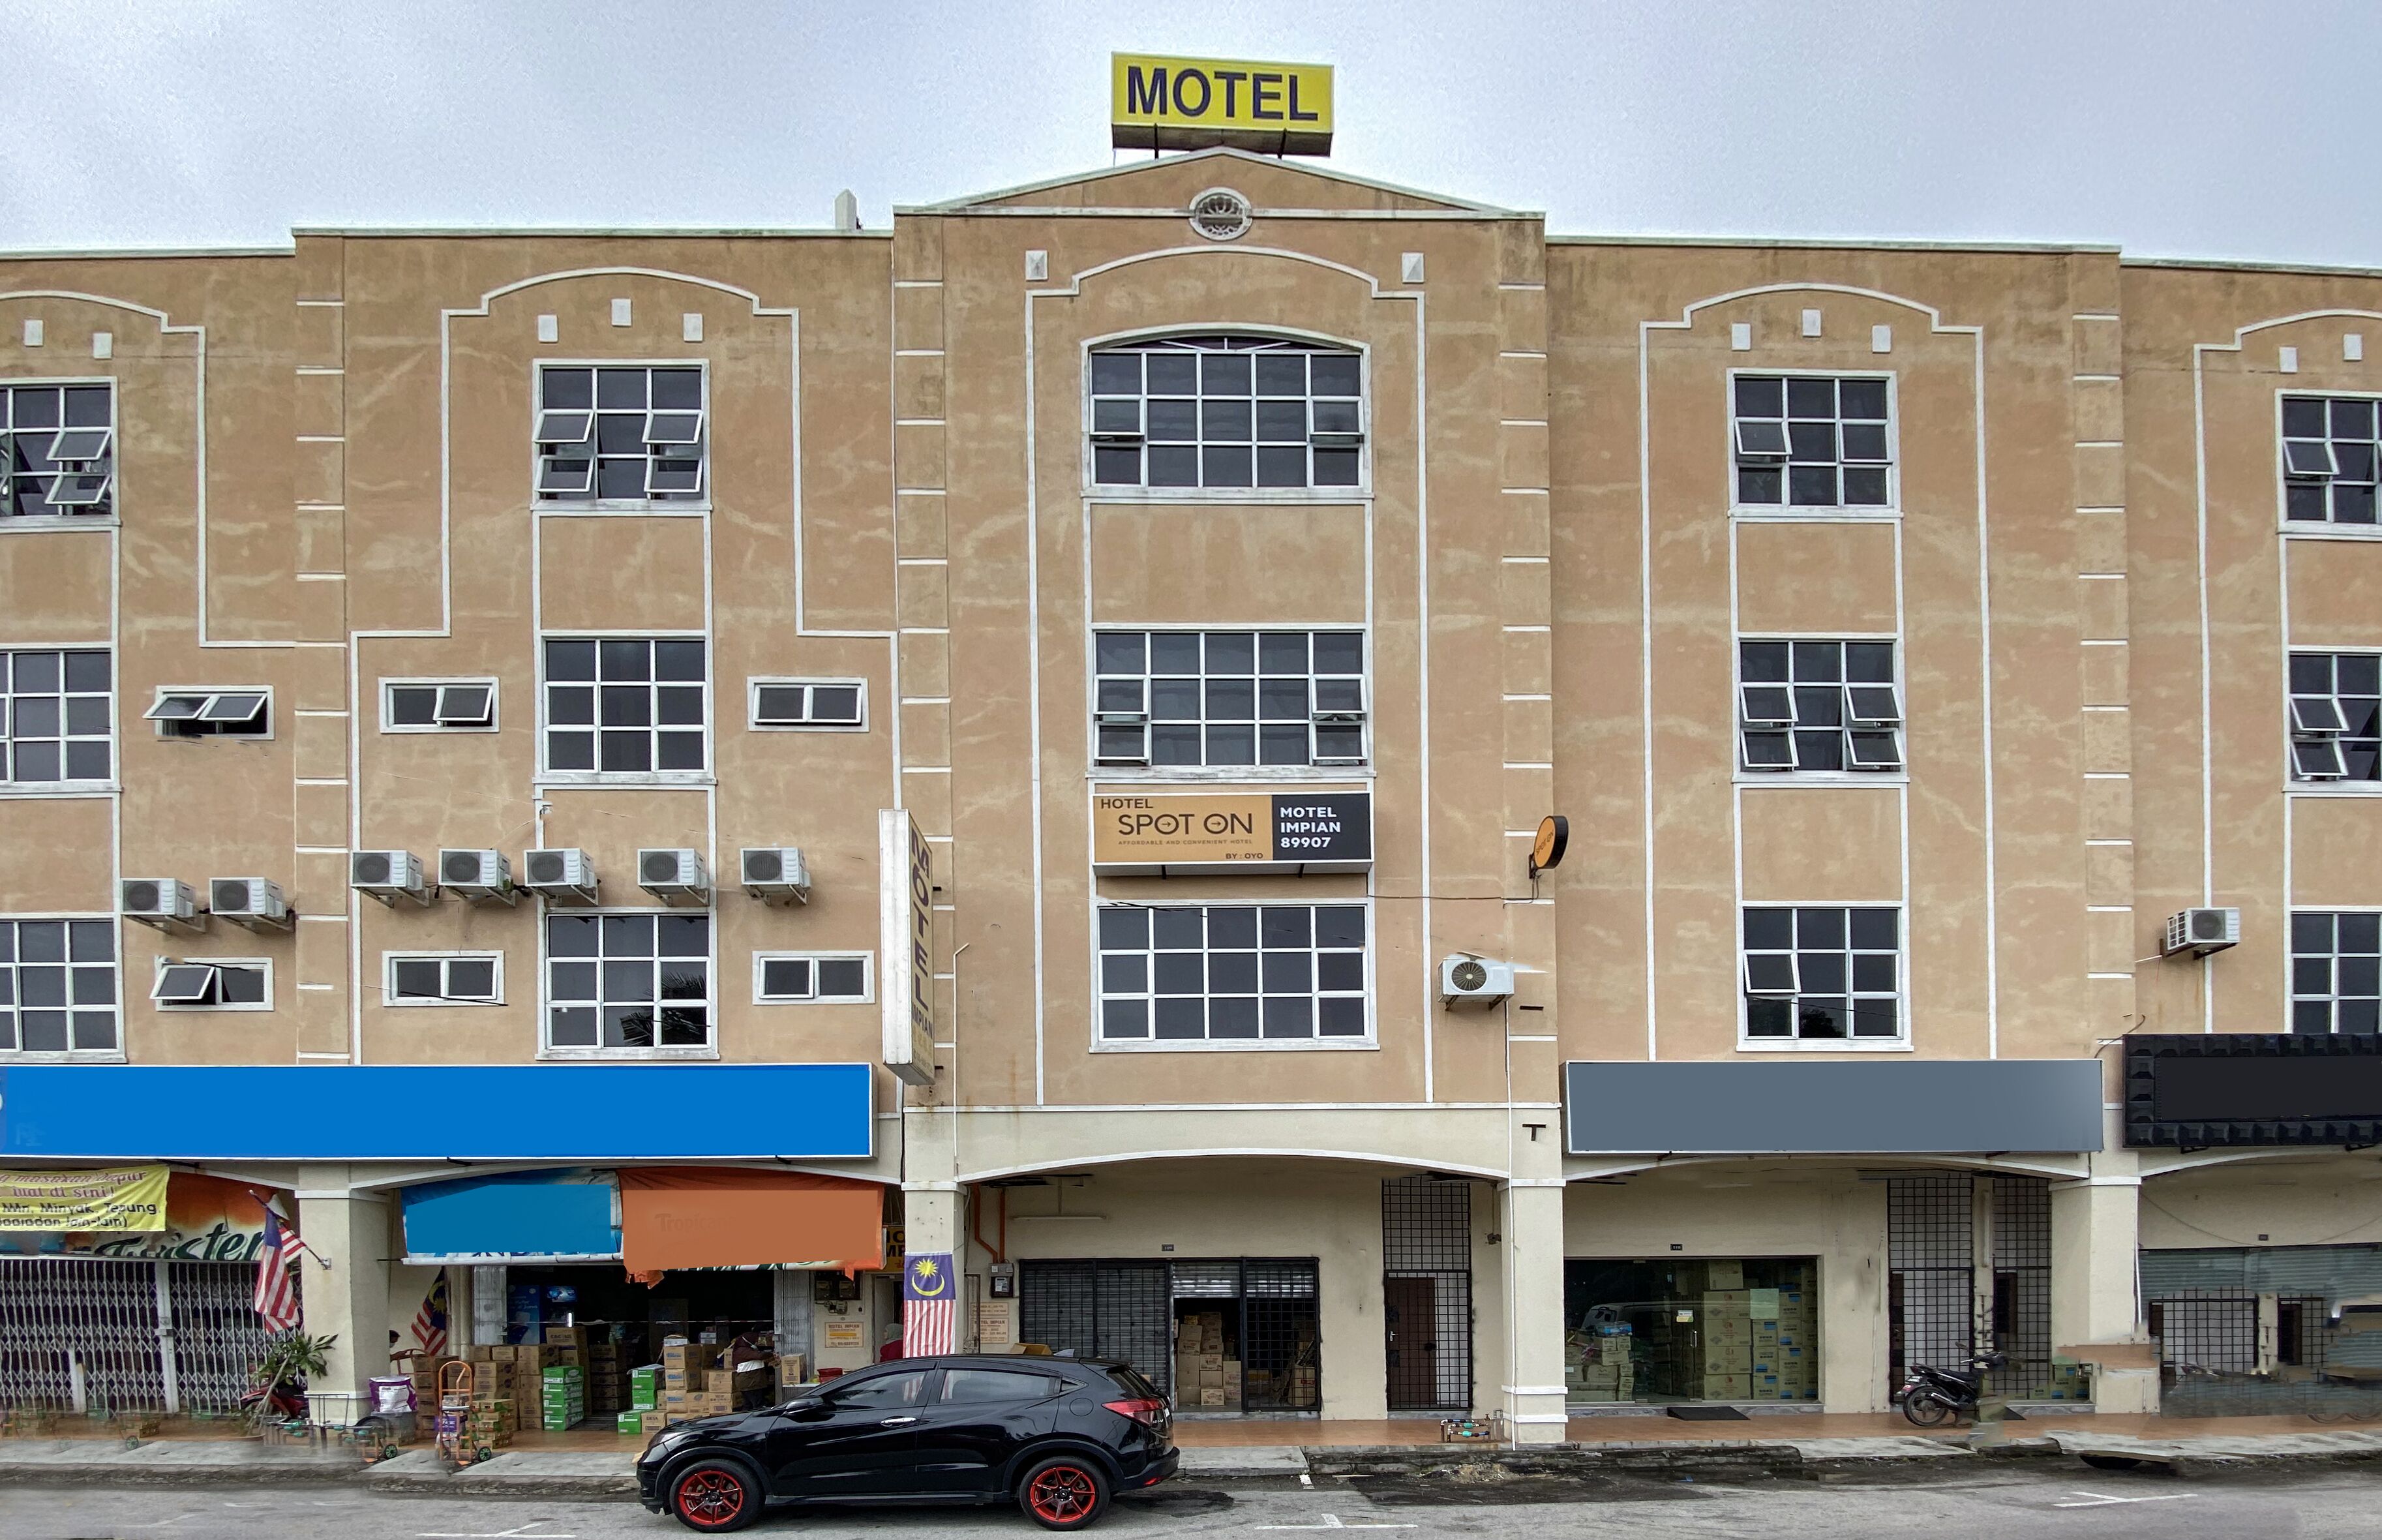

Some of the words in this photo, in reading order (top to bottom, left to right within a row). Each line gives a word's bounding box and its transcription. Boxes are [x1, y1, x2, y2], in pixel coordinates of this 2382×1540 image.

[1127, 65, 1318, 121] MOTEL
[1100, 798, 1154, 809] HOTEL
[1280, 806, 1337, 819] MOTEL
[1117, 813, 1195, 836] SPOT
[1203, 813, 1253, 835] ON
[1280, 822, 1341, 834] IMPIAN
[1280, 836, 1331, 849] 89907
[912, 826, 929, 1013] MOTEL
